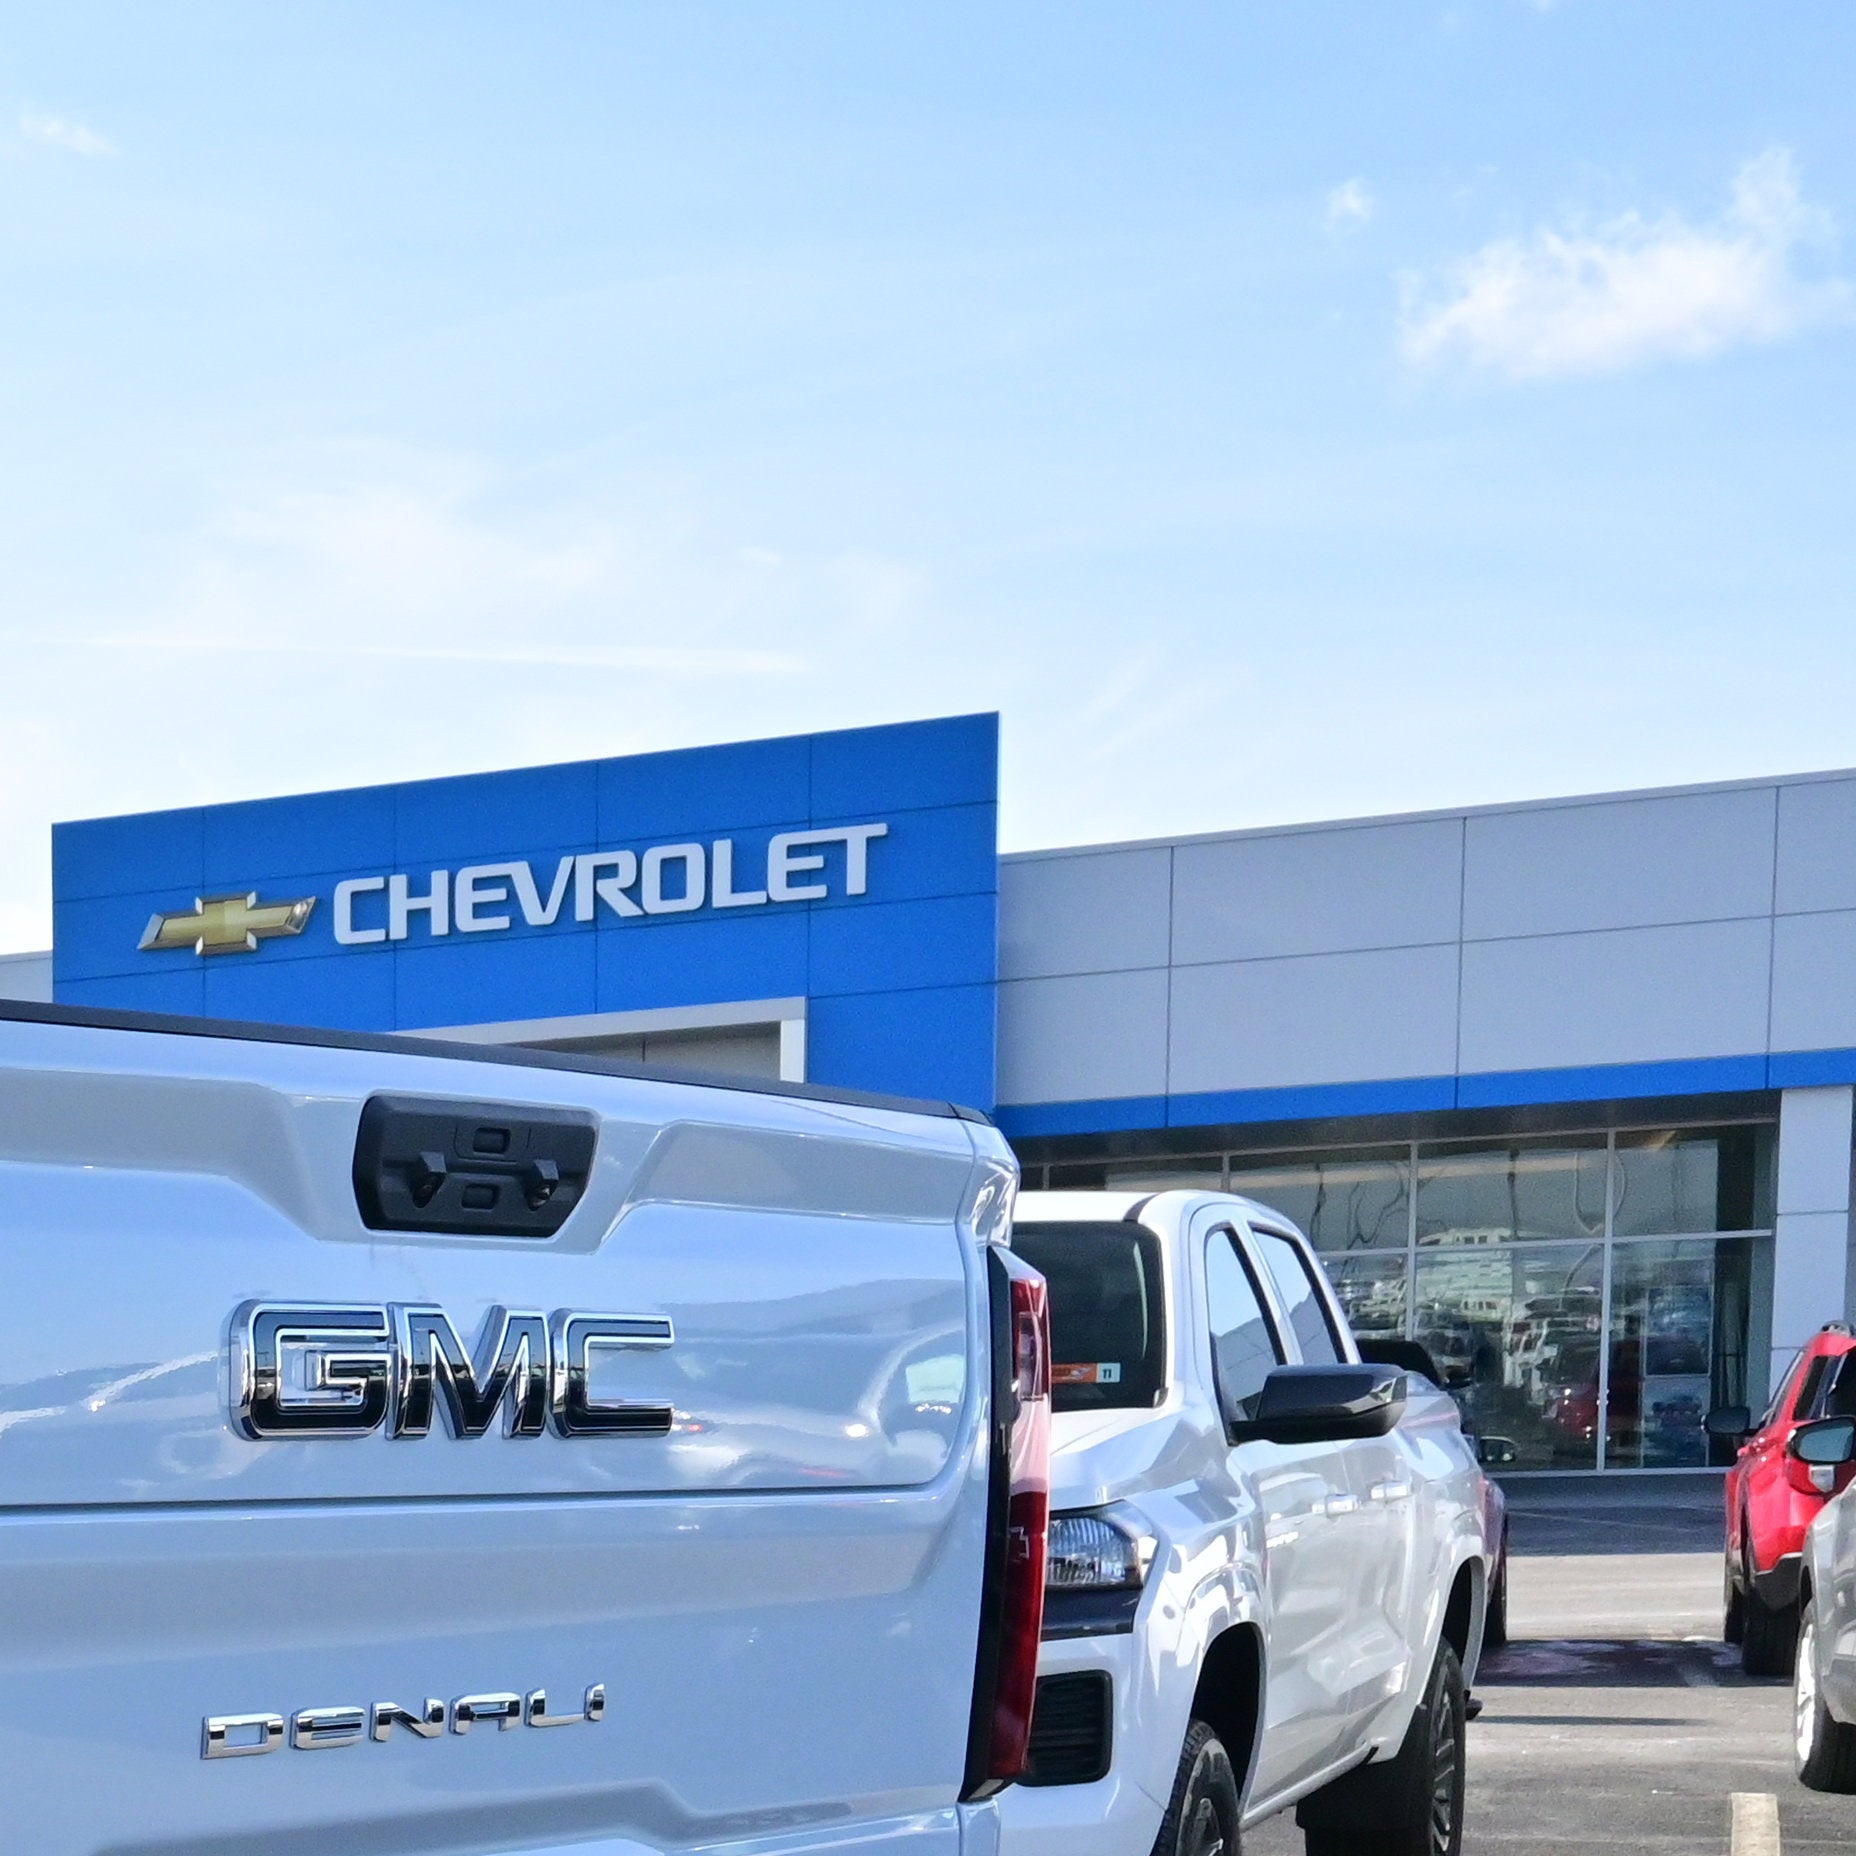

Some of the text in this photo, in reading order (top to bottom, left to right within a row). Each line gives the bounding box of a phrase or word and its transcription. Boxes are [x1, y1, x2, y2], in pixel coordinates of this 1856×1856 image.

[333, 822, 888, 945] CHEVROLET
[228, 1298, 676, 1441] GMC
[200, 1682, 606, 1761] DENALI
